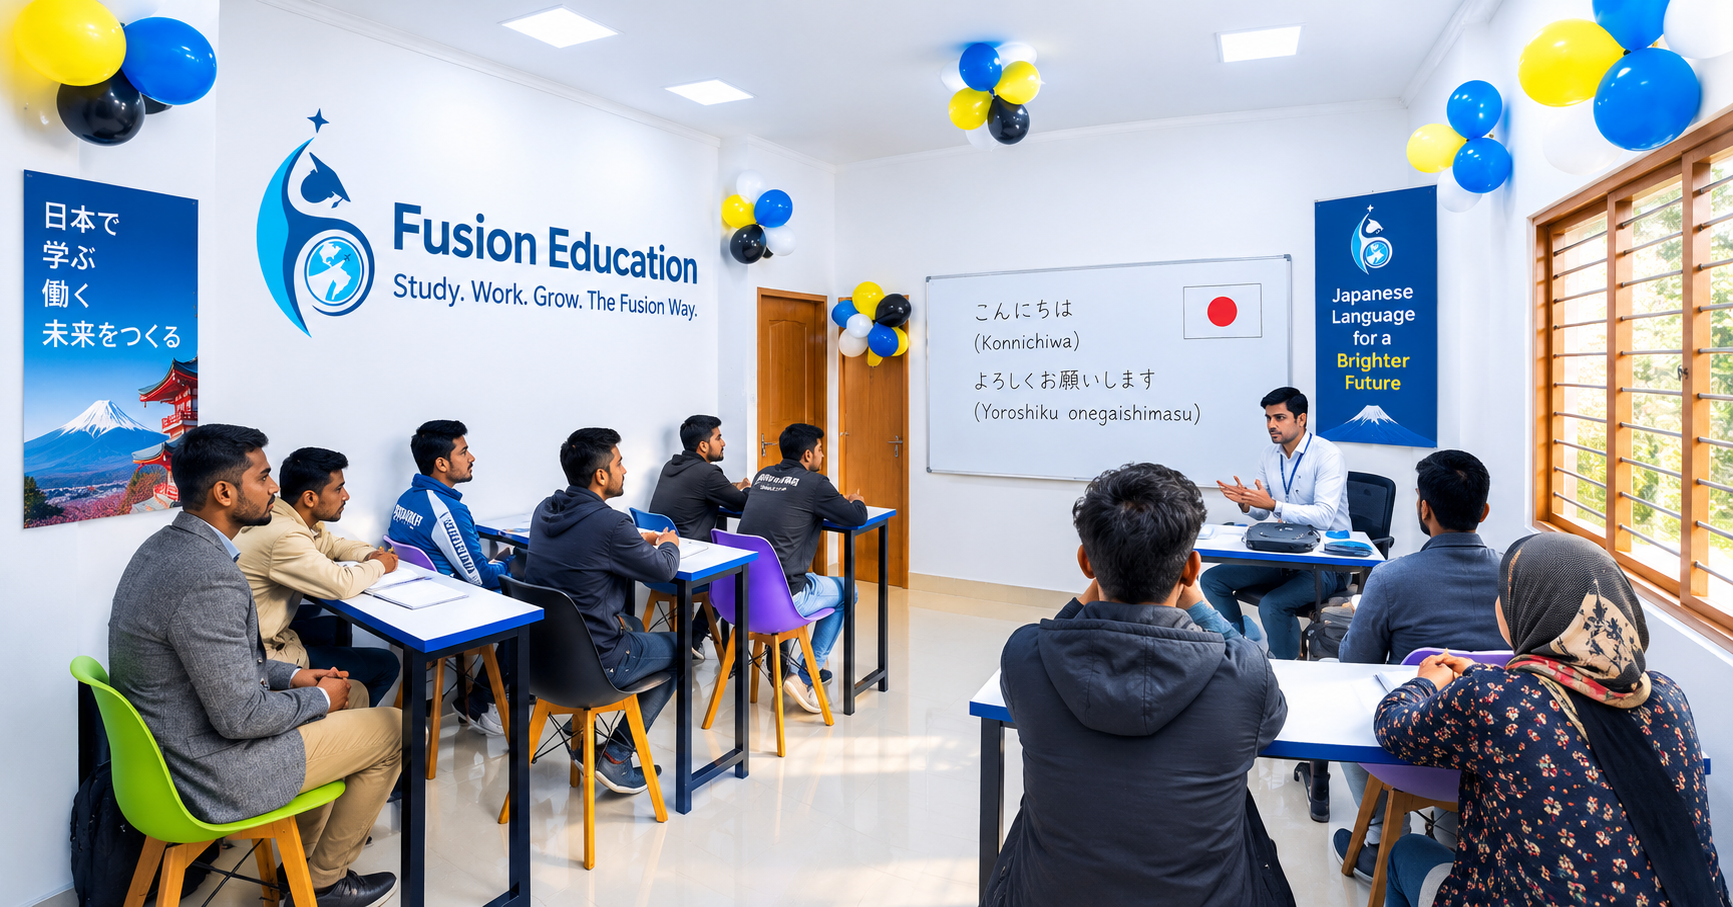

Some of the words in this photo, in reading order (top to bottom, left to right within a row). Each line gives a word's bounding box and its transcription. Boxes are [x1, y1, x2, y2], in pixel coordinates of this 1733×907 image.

[46, 202, 119, 235] 日本で
[43, 241, 95, 269] 学ぶ
[394, 202, 536, 265] Fusion
[549, 227, 697, 284] Education
[42, 279, 88, 308] 働く
[394, 274, 464, 307] Study.
[471, 280, 527, 305] Work.
[534, 286, 582, 309] Grow.
[587, 290, 615, 311] The
[621, 294, 664, 314] Fusion
[669, 298, 697, 321] Way.
[1333, 288, 1413, 305] Japanese
[975, 299, 1073, 322] こんにちは
[1333, 310, 1415, 326] Language
[43, 320, 180, 348] 未来をつくる
[974, 330, 1080, 354] (Konnichiwa)
[1353, 331, 1377, 345] for
[1382, 334, 1391, 344] a
[1338, 352, 1410, 372] Brighter
[974, 368, 1155, 391] よろしくお願いします
[1346, 376, 1400, 390] Future
[974, 401, 1059, 423] (Yoroshiku
[1068, 403, 1201, 427] onegaishimasu)
